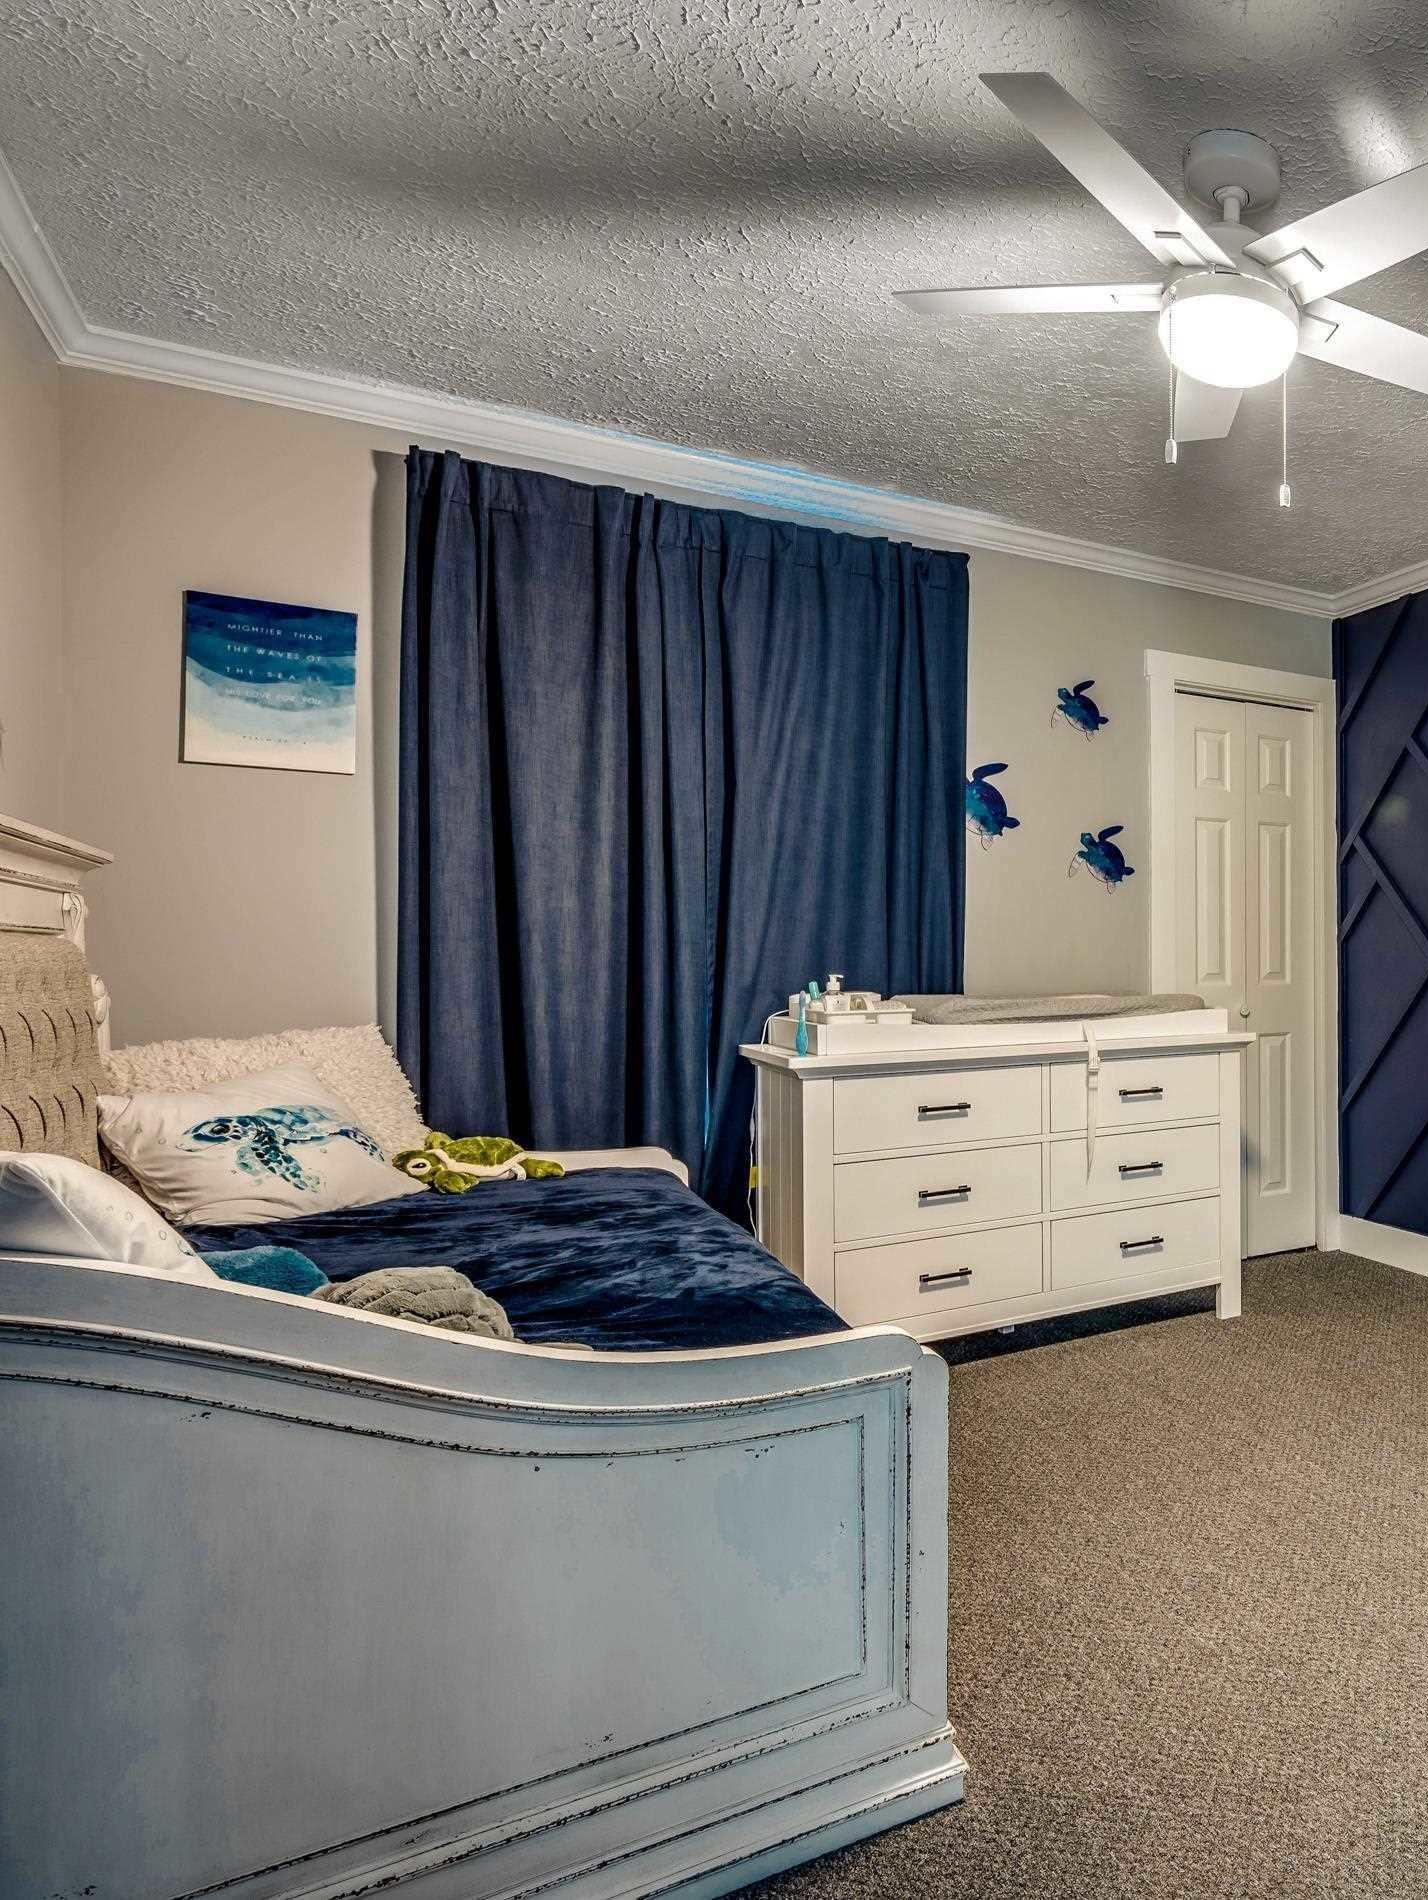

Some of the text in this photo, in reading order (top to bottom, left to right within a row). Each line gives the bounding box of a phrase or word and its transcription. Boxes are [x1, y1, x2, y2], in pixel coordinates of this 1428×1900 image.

[227, 624, 323, 641] MIGHTIER THAN
[227, 644, 249, 654] THE
[256, 647, 300, 660] WAVES
[266, 671, 297, 681] SEA
